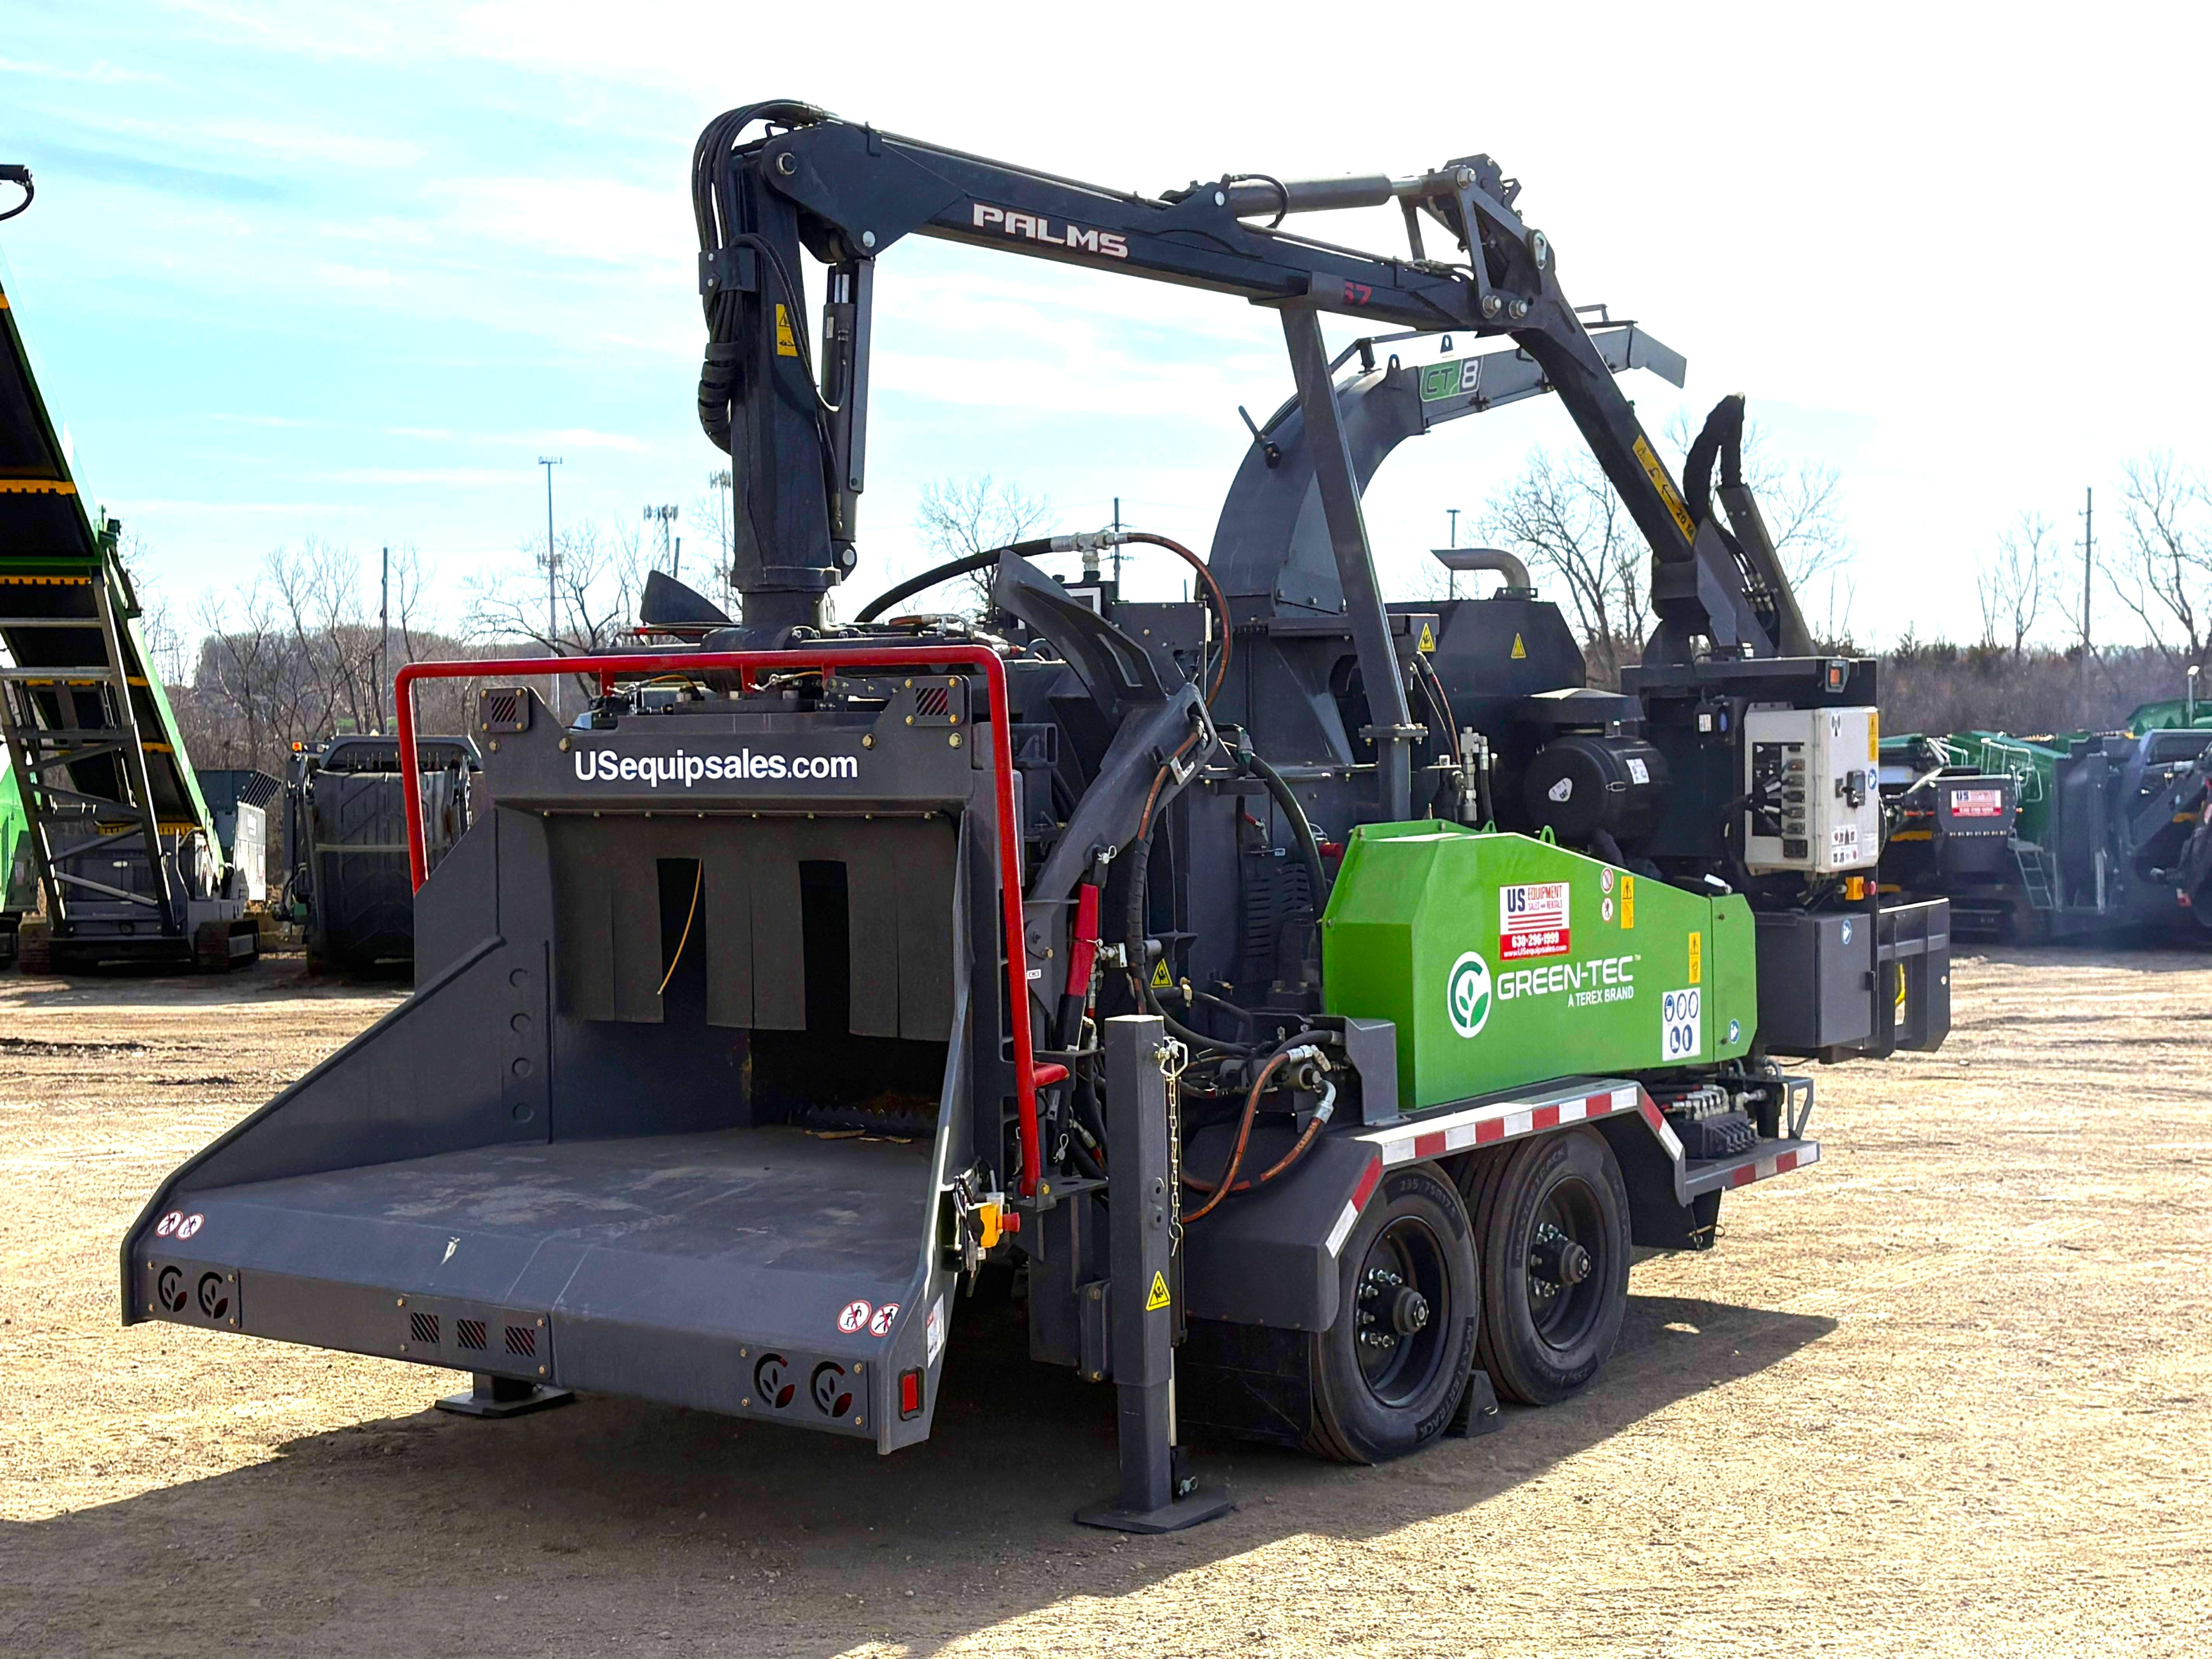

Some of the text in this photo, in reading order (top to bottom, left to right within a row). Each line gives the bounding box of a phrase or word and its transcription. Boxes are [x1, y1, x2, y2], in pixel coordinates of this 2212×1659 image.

[973, 203, 1128, 258] PALMS
[1462, 360, 1479, 388] 8
[575, 748, 858, 787] USequipsales.com
[1507, 885, 1562, 912] US EQUIPMENT
[1497, 955, 1634, 1000] GREEN-TEC
[1568, 986, 1634, 1007] A TEREX BRAND
